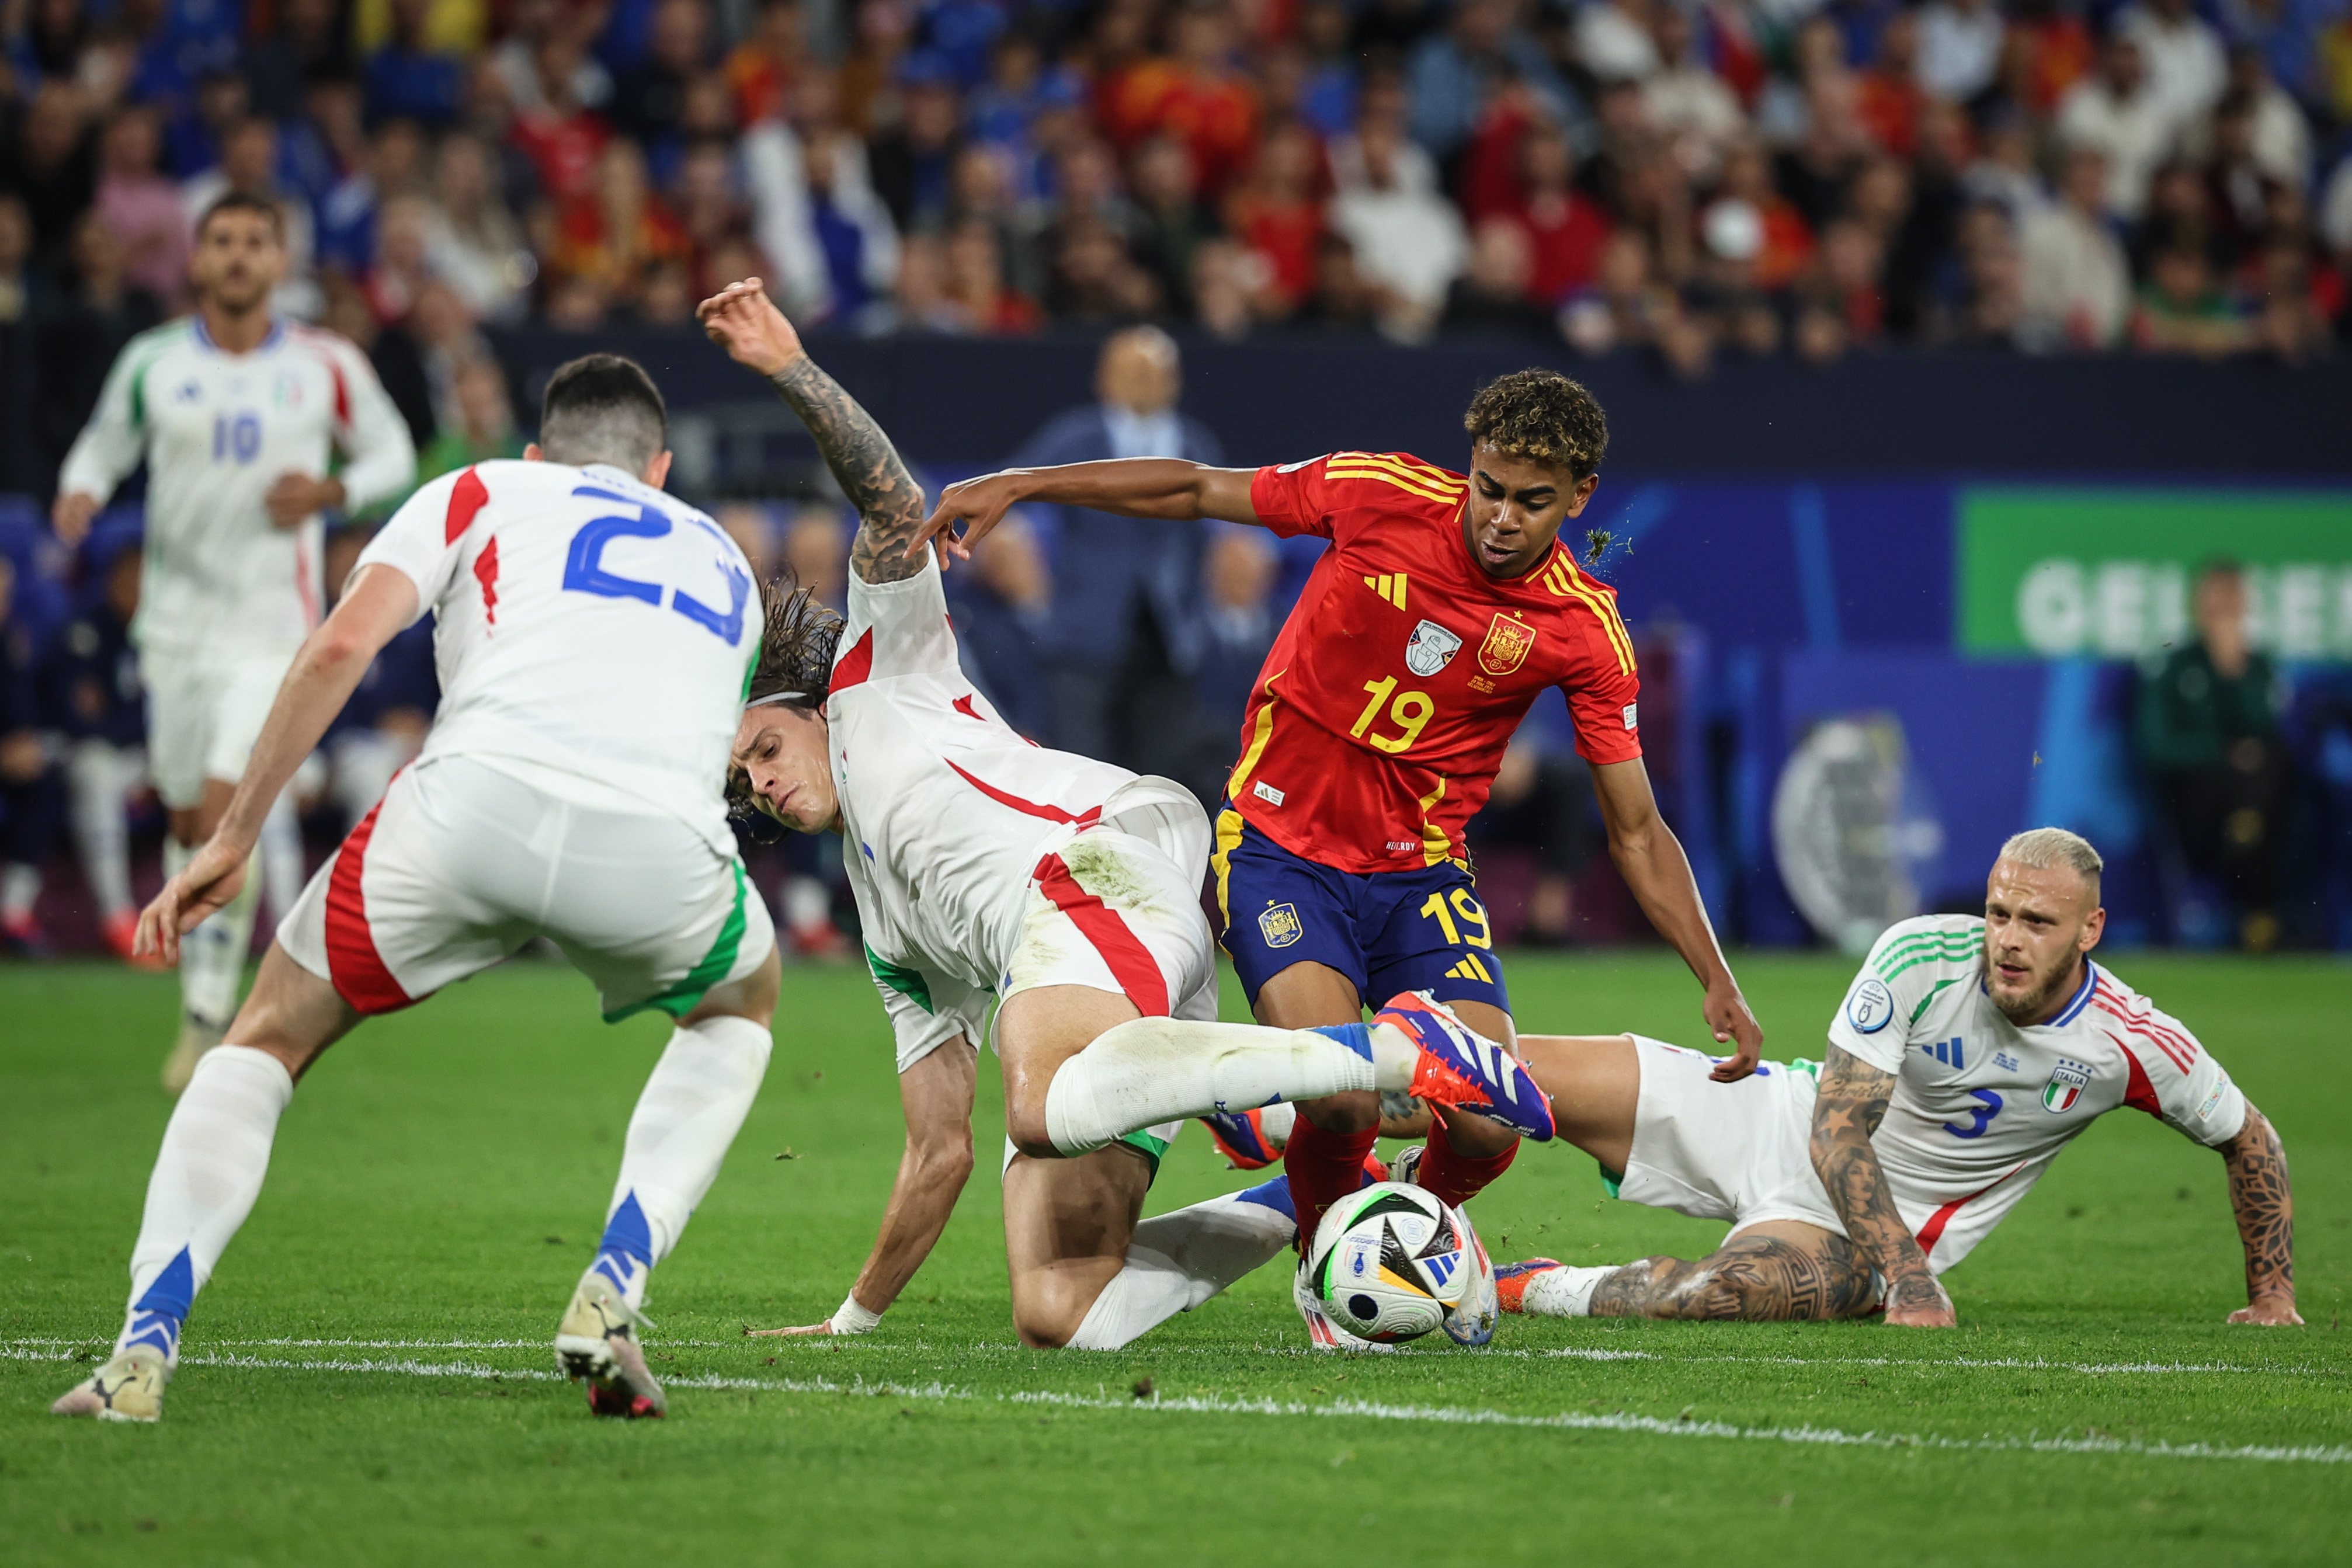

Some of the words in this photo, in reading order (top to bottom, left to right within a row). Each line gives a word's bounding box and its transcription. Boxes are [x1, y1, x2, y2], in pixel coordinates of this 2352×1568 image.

[211, 411, 262, 463] 10
[562, 486, 750, 647] 23
[1349, 675, 1435, 754] 19
[1420, 888, 1492, 950] 19
[2056, 1070, 2084, 1085] ITALIA
[1943, 1089, 2003, 1138] 3
